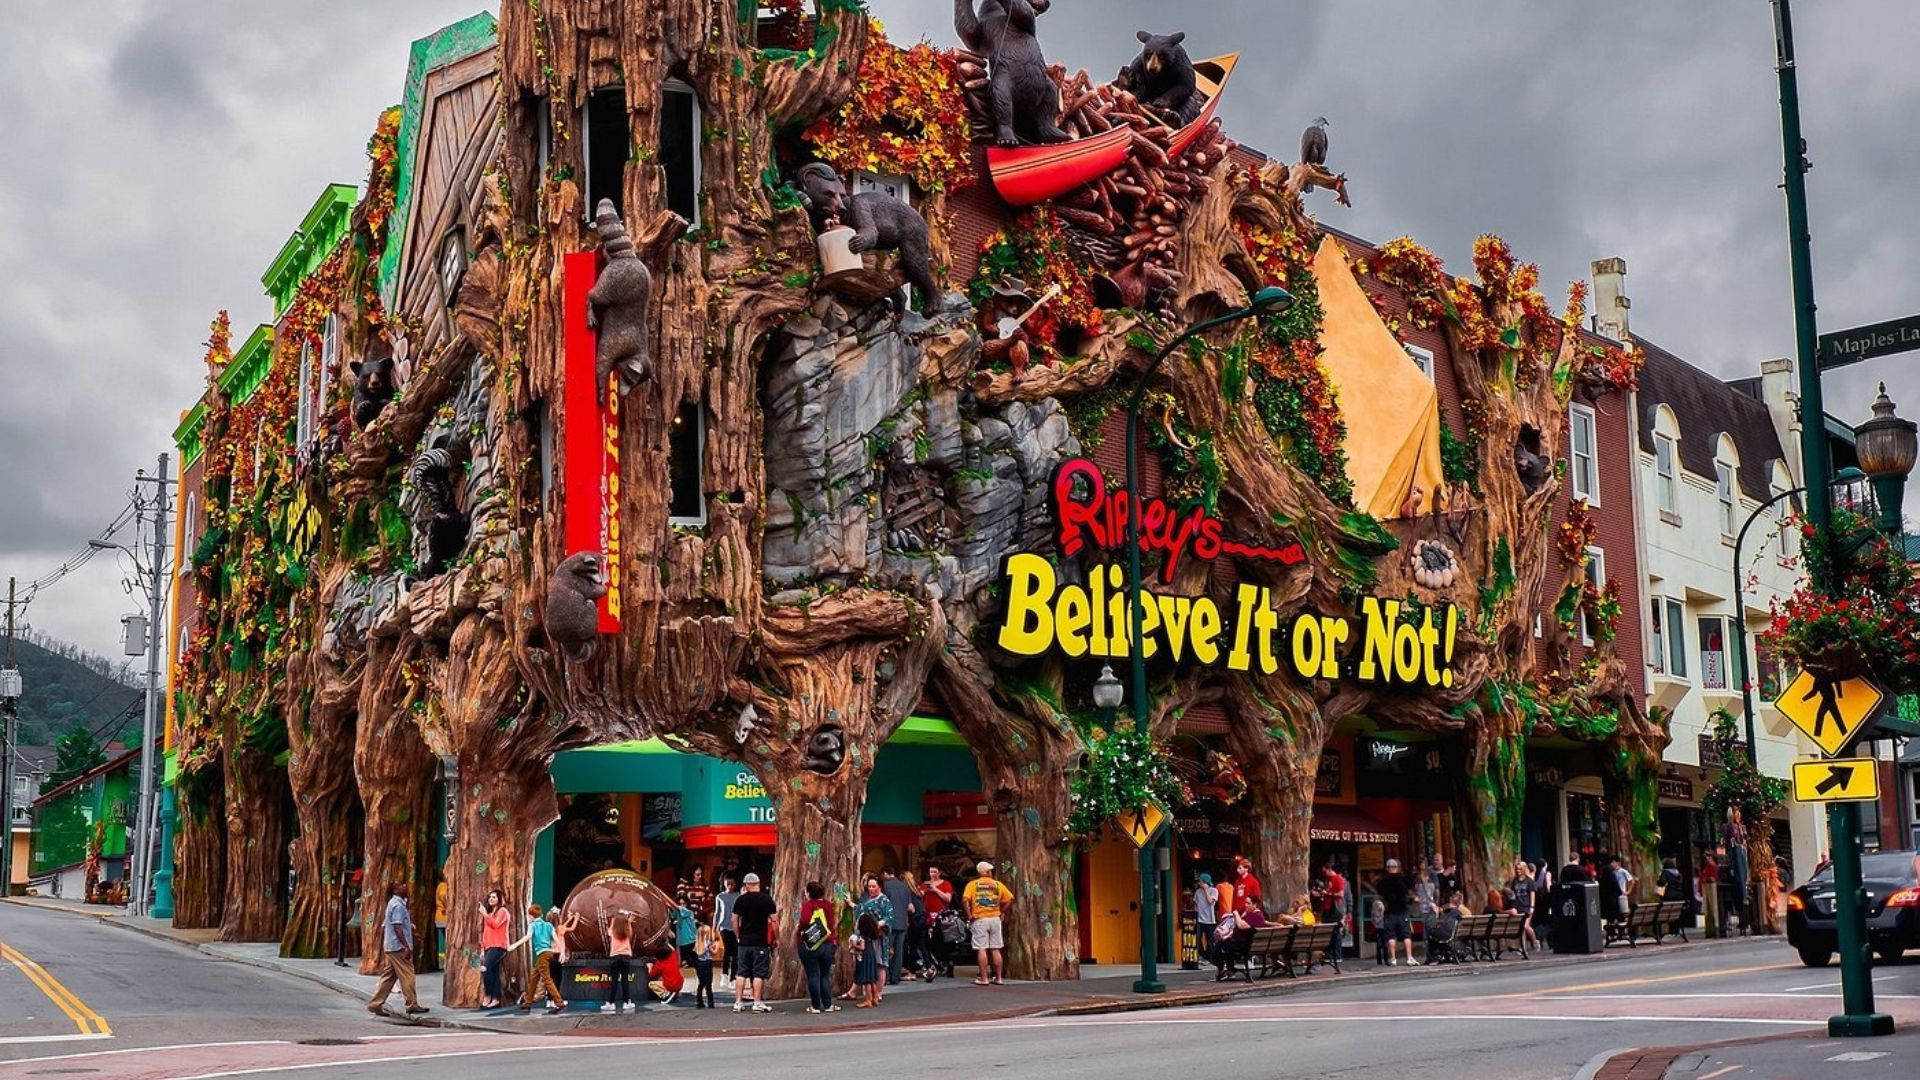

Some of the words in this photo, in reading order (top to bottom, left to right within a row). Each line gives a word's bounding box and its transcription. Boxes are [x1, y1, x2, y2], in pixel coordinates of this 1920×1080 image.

[609, 370, 619, 415] or
[606, 423, 619, 463] It
[608, 472, 621, 622] Believe
[998, 553, 1221, 664] Believe
[1228, 583, 1278, 675] It
[1292, 613, 1349, 679] or
[1358, 597, 1457, 688] Not!
[1311, 829, 1340, 840] SHOPPE
[1353, 832, 1367, 842] THE
